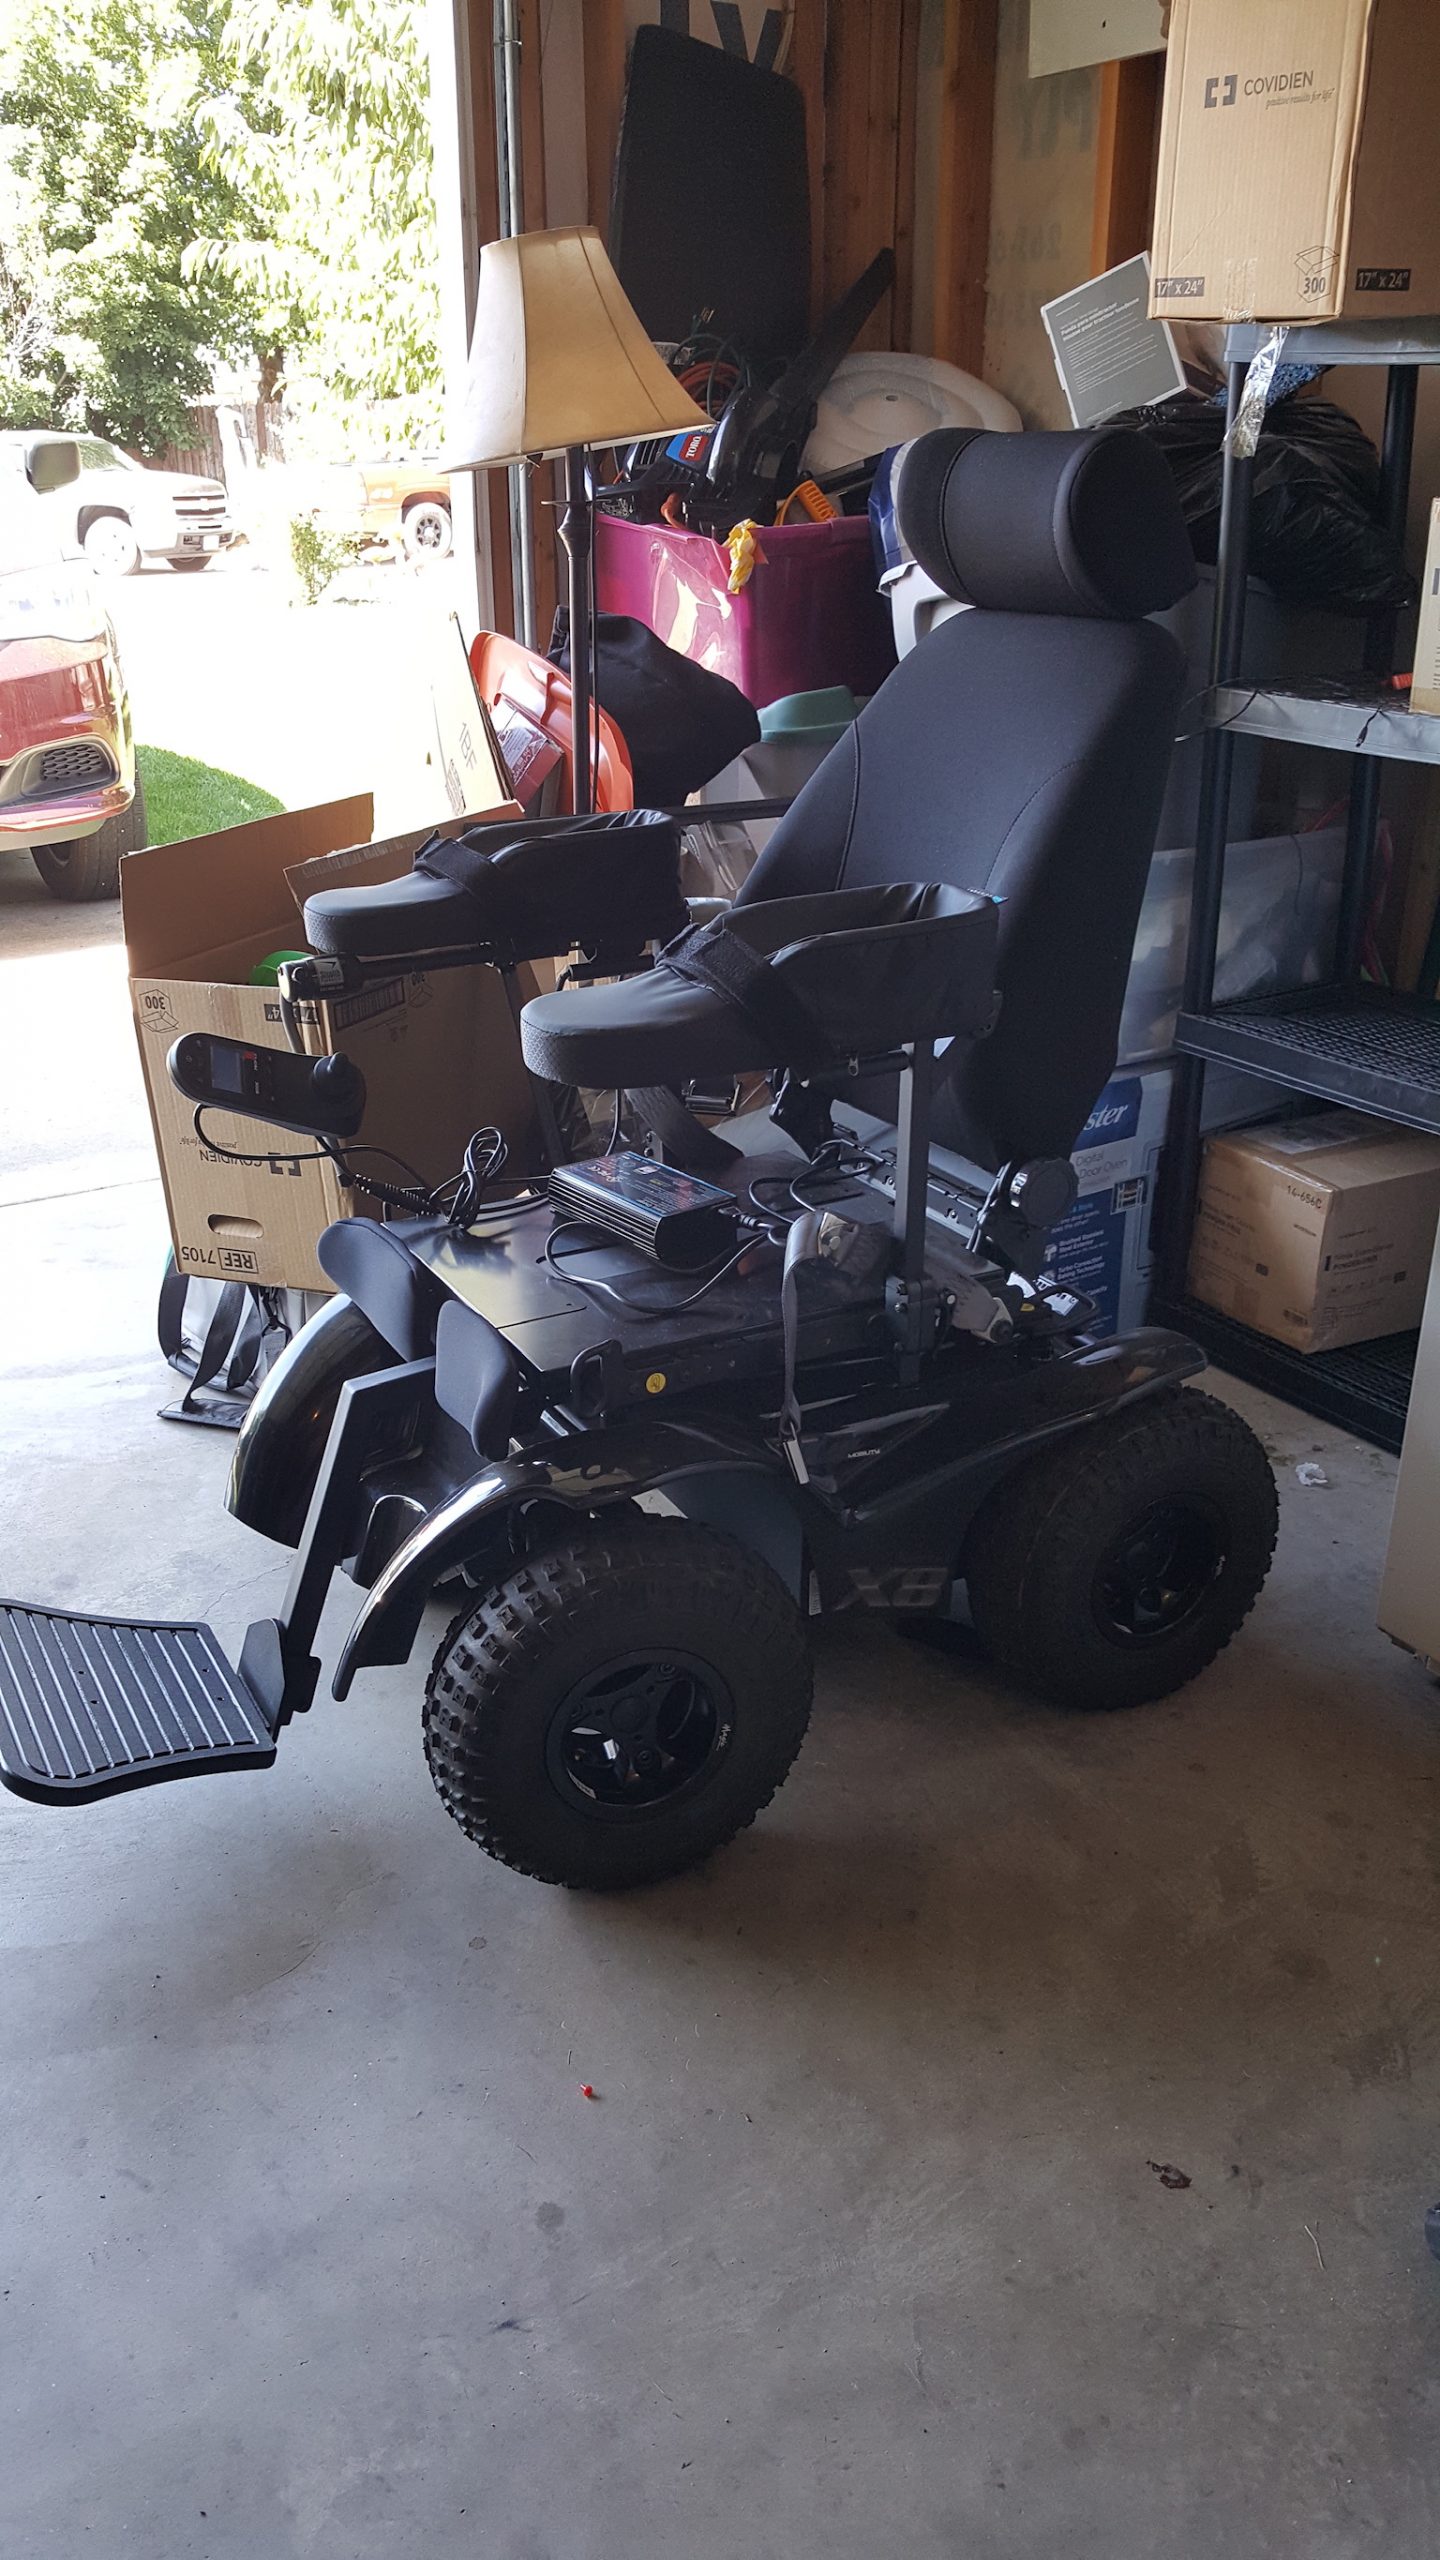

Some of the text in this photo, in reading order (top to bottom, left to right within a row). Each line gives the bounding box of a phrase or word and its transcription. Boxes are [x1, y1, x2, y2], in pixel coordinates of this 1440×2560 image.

[1243, 70, 1314, 96] COVIDIEN
[1156, 279, 1204, 296] 17" x 24"
[1303, 276, 1326, 295] 300
[1358, 271, 1410, 288] 17" x 24"
[685, 435, 703, 458] TORO
[145, 995, 166, 1010] 300
[1083, 1104, 1129, 1131] ster
[199, 1150, 263, 1167] COVIDIEN
[181, 1246, 254, 1270] REF 7105
